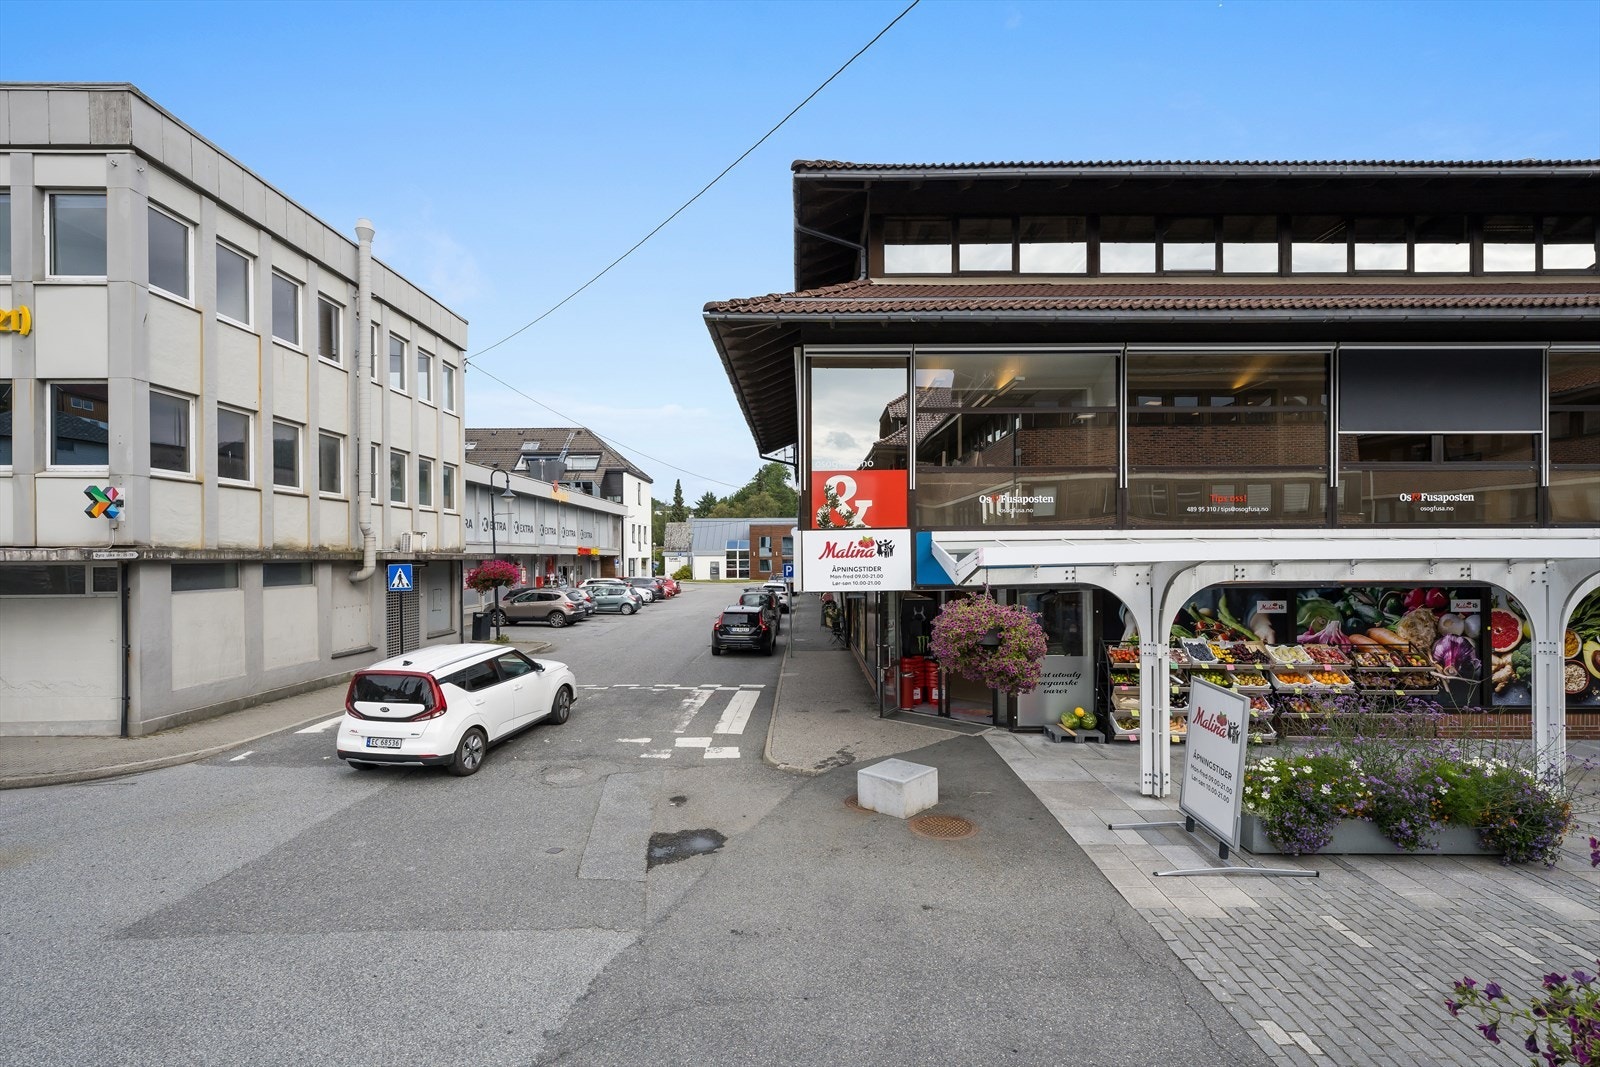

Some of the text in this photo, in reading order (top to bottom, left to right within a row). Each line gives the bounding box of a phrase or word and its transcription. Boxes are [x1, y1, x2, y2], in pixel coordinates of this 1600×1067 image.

[979, 495, 991, 504] Os
[1001, 494, 1055, 506] Fusaposten
[1210, 494, 1247, 504] Tips oss!
[1399, 493, 1411, 502] Os
[1421, 492, 1475, 504] Fusaposten
[1221, 505, 1269, 514] tips@osogfusa.no
[1419, 505, 1454, 513] osogfusa.no
[519, 523, 534, 534] EXTRA
[544, 526, 557, 536] EXTRA
[565, 528, 576, 537] EXTRA
[818, 541, 875, 560] Malina
[831, 564, 882, 573] ÅPNINGSTIDER
[1193, 706, 1228, 739] Malina
[371, 738, 379, 746] EC
[380, 739, 400, 747] 68536
[1192, 749, 1233, 781] ÅPNINGSTIDER
